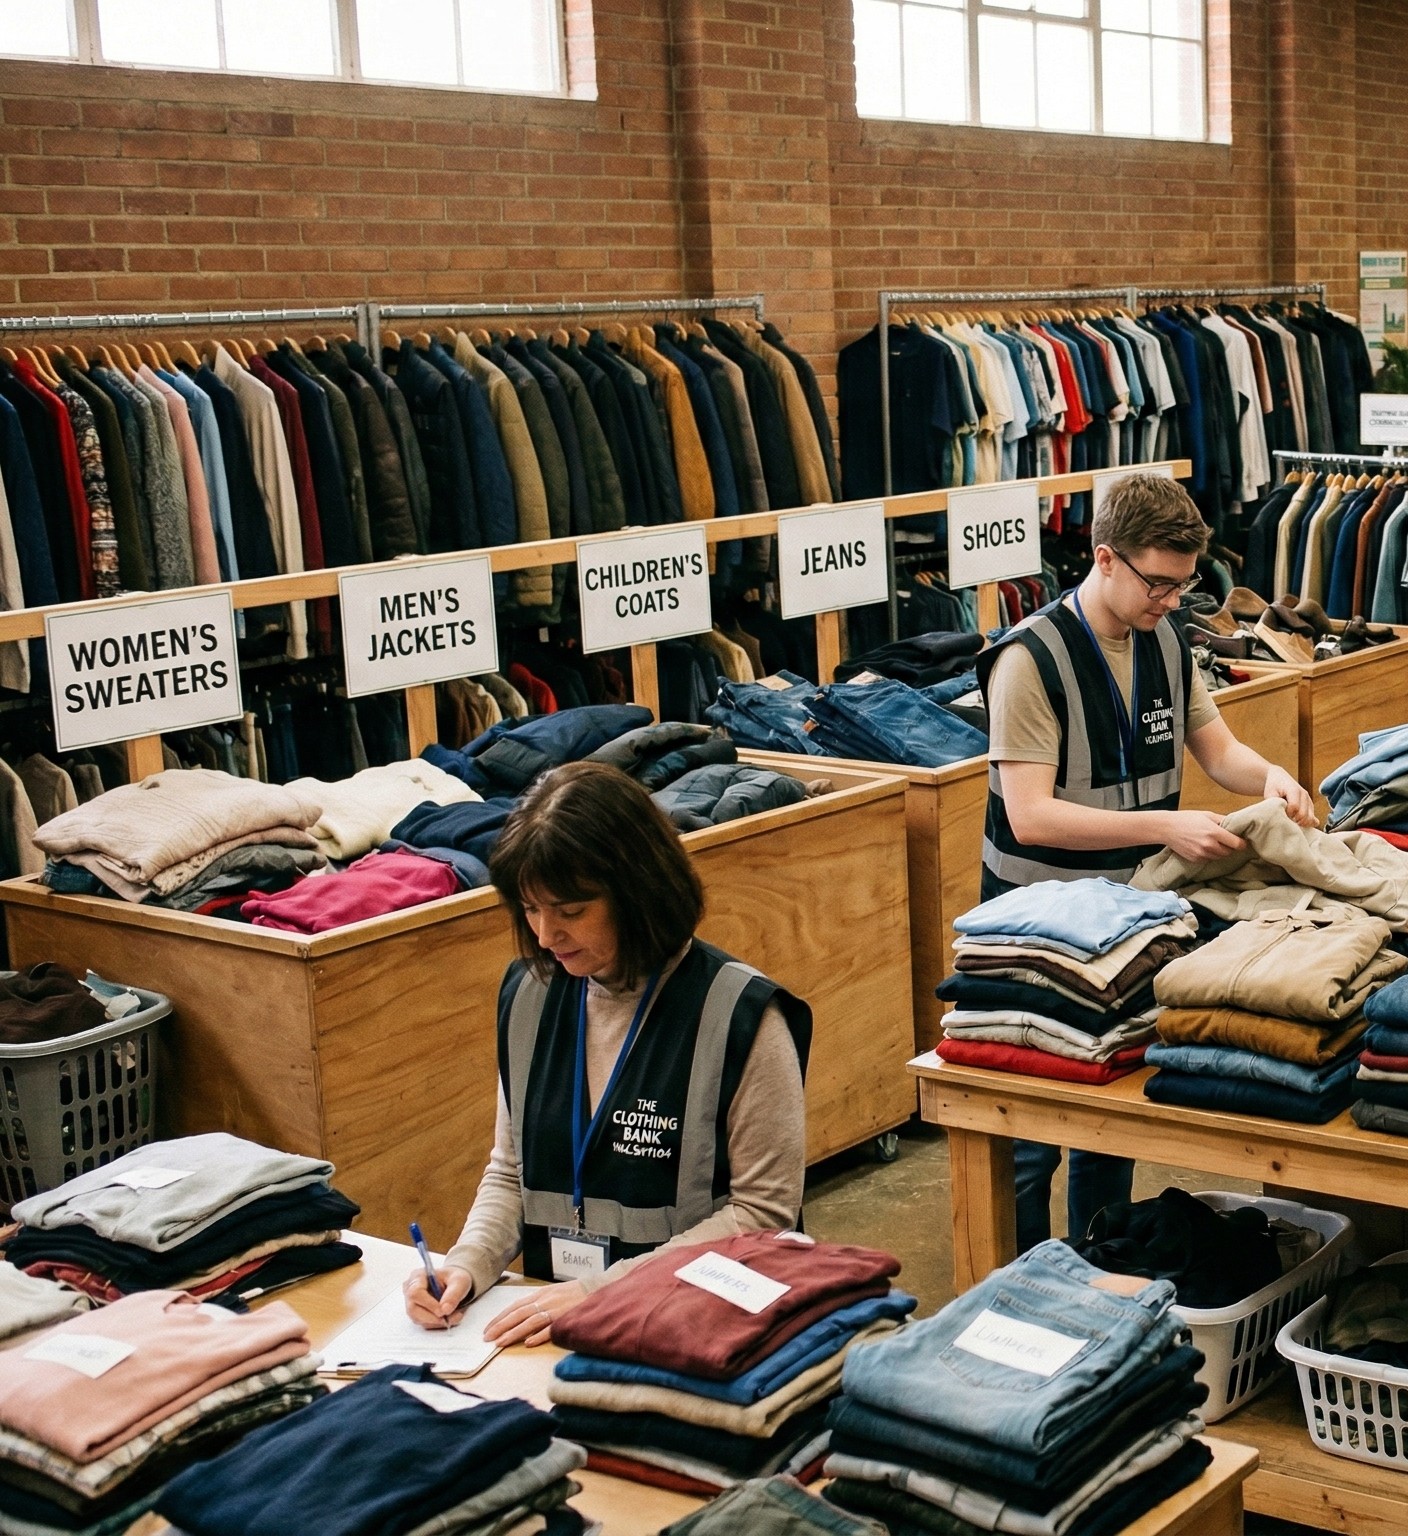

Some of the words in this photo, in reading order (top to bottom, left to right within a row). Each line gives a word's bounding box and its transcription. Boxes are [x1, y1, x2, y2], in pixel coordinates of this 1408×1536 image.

[963, 517, 1026, 551] SHOES
[585, 553, 703, 591] CHILDREN'S
[800, 540, 867, 576] JEANS
[379, 587, 460, 623] MEN'S
[615, 587, 680, 618] COATS
[67, 623, 218, 672] WOMEN'S
[367, 619, 476, 661] JACKETS
[64, 660, 228, 713] SWEATERS
[612, 1110, 678, 1131] CLOTHING
[637, 1099, 658, 1112] THE
[623, 1127, 663, 1145] BANK
